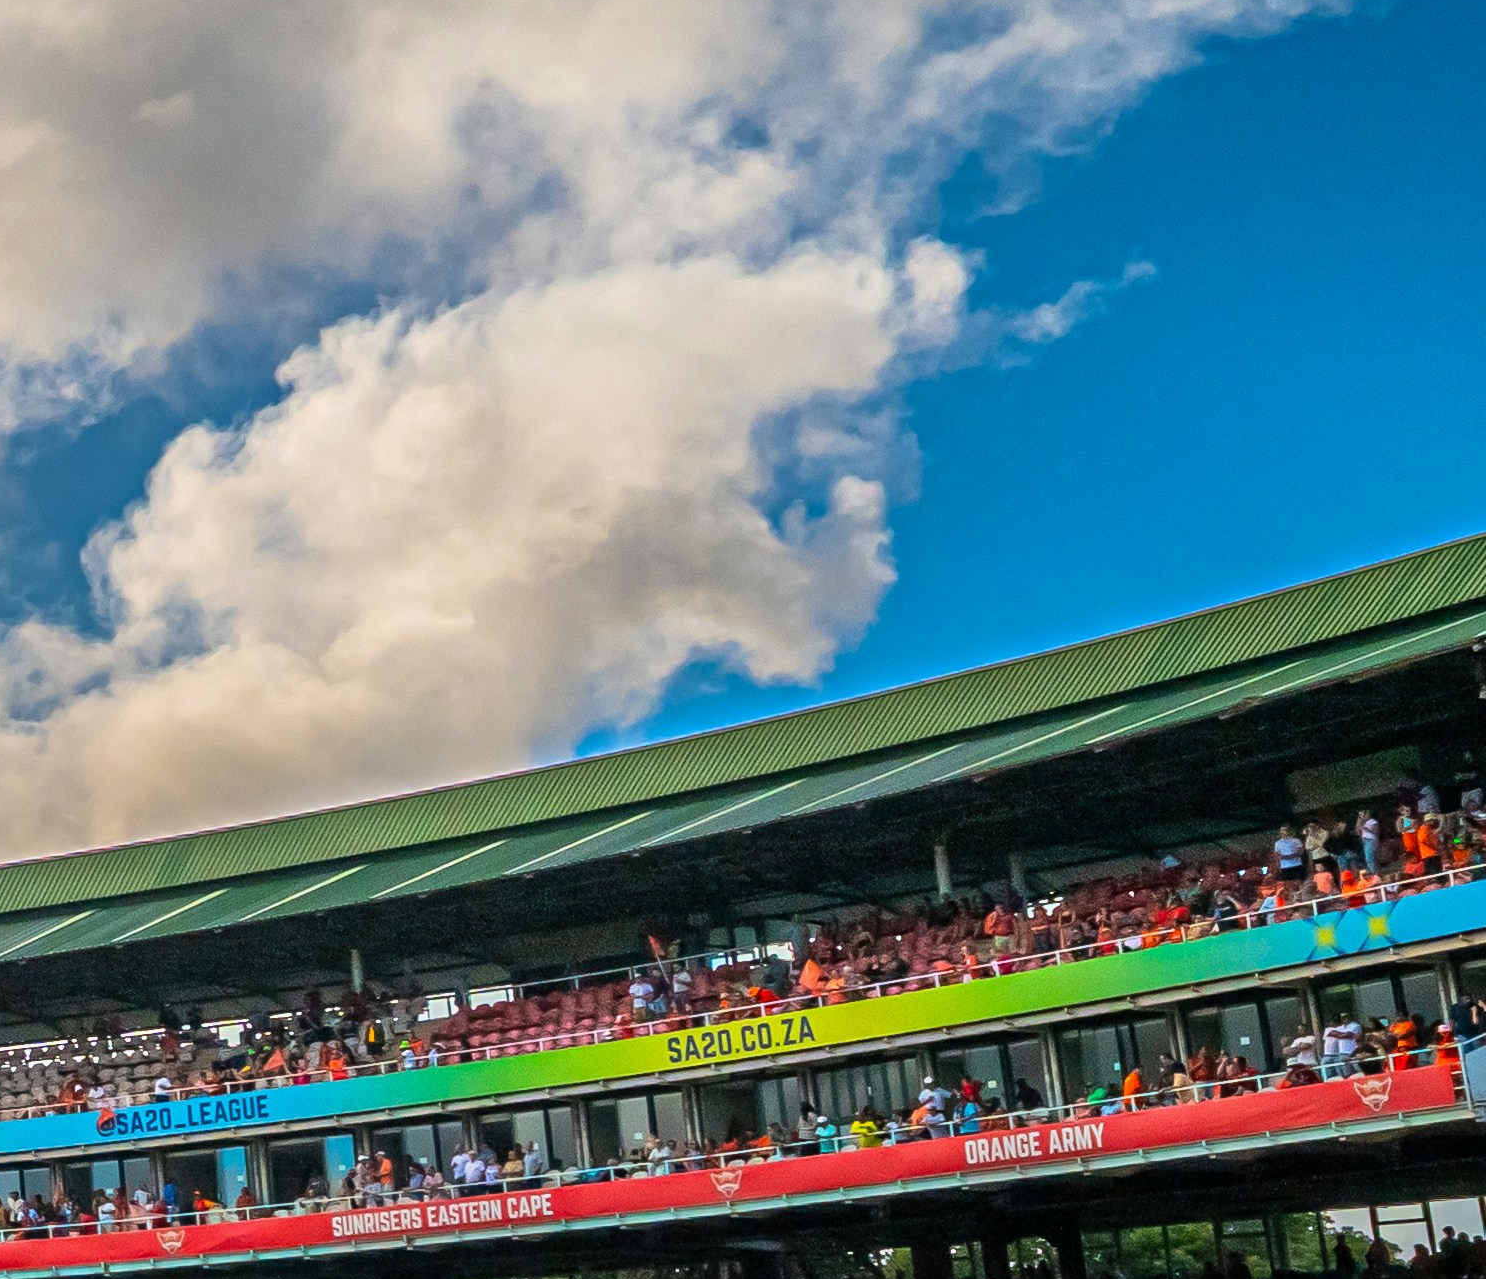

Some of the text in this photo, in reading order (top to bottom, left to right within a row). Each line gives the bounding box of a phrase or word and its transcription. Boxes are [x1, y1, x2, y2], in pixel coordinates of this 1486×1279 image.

[667, 1015, 815, 1063] SA20.CO.ZA
[964, 1123, 1104, 1164] ORANGE ARMY
[331, 1193, 554, 1237] SUNRISERS EASTERN CAPE
